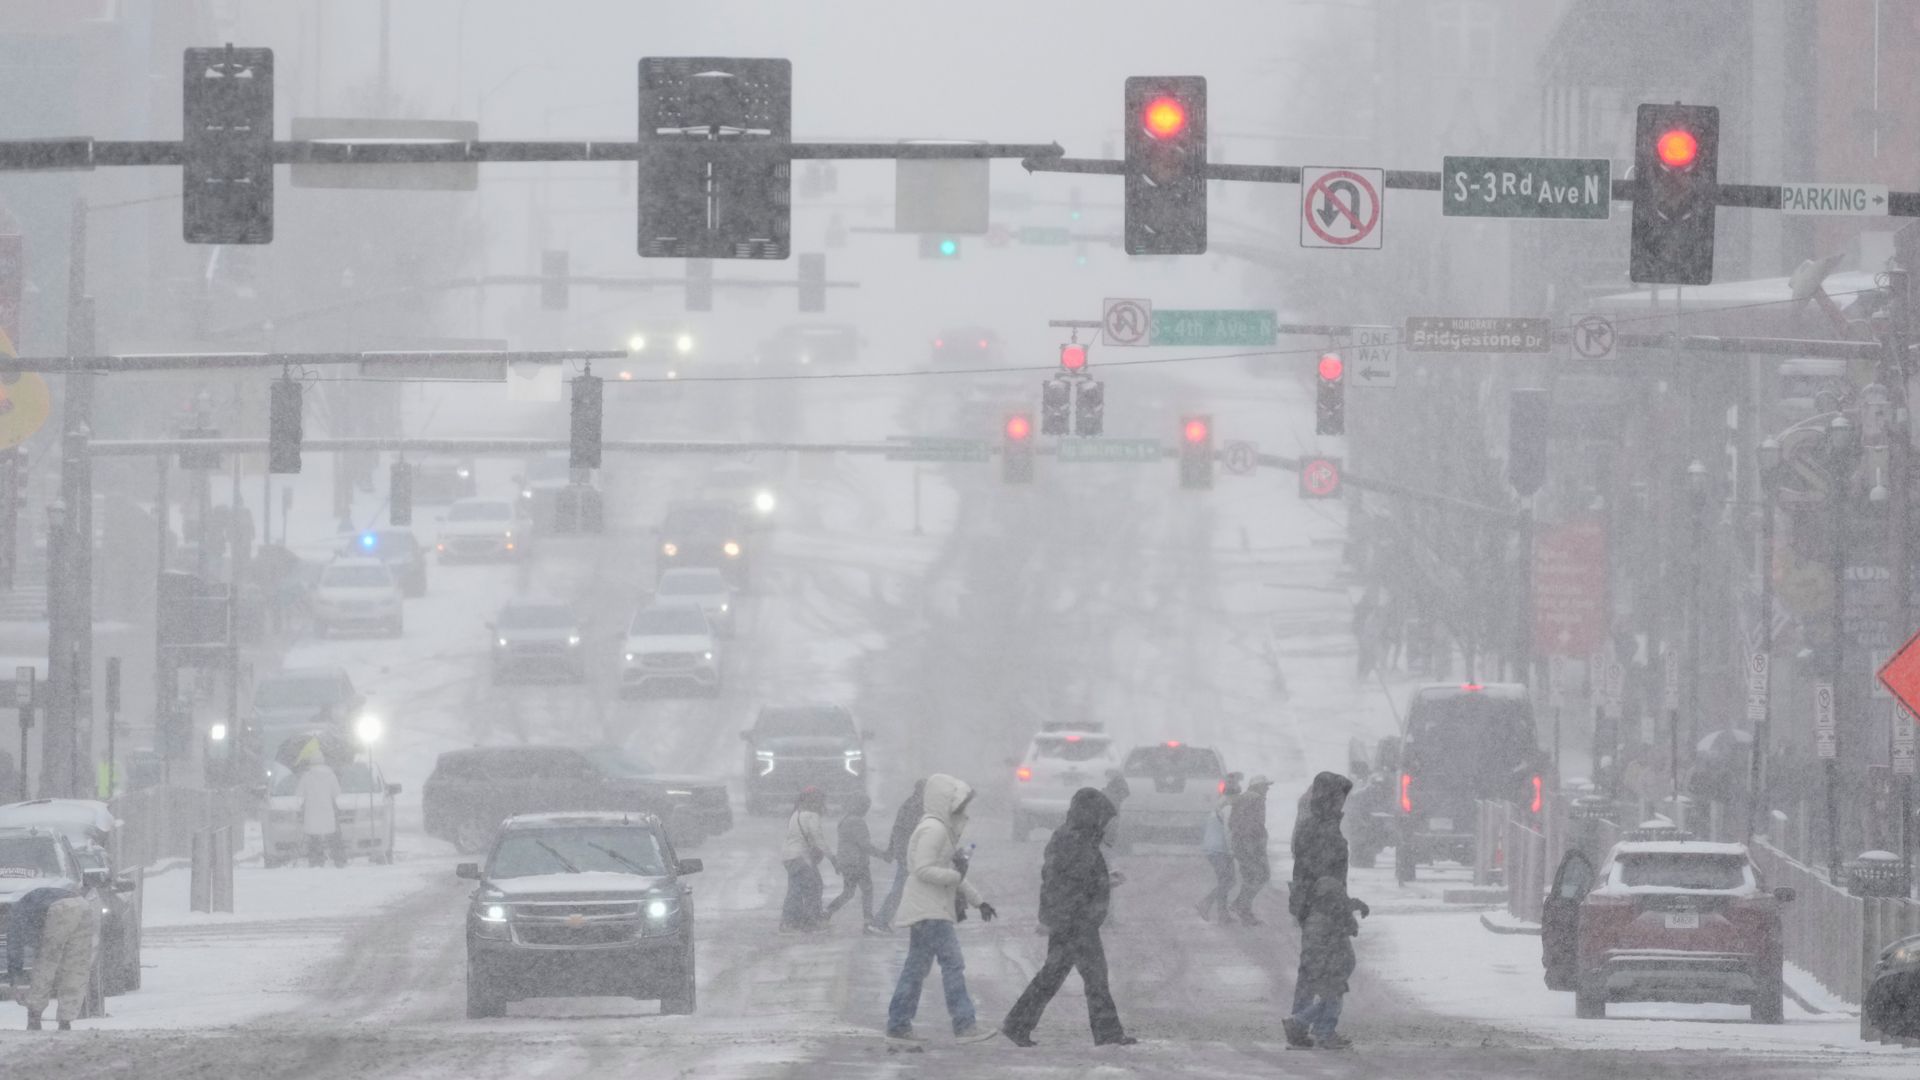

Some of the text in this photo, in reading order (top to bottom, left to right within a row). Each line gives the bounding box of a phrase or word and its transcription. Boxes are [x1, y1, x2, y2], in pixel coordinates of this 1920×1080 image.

[1538, 180, 1579, 204] Ave
[1584, 174, 1599, 205] N
[1782, 187, 1867, 211] PARKING
[1359, 331, 1390, 345] ONE
[1414, 329, 1542, 349] Bridgestone Dr
[1358, 348, 1391, 362] WAY
